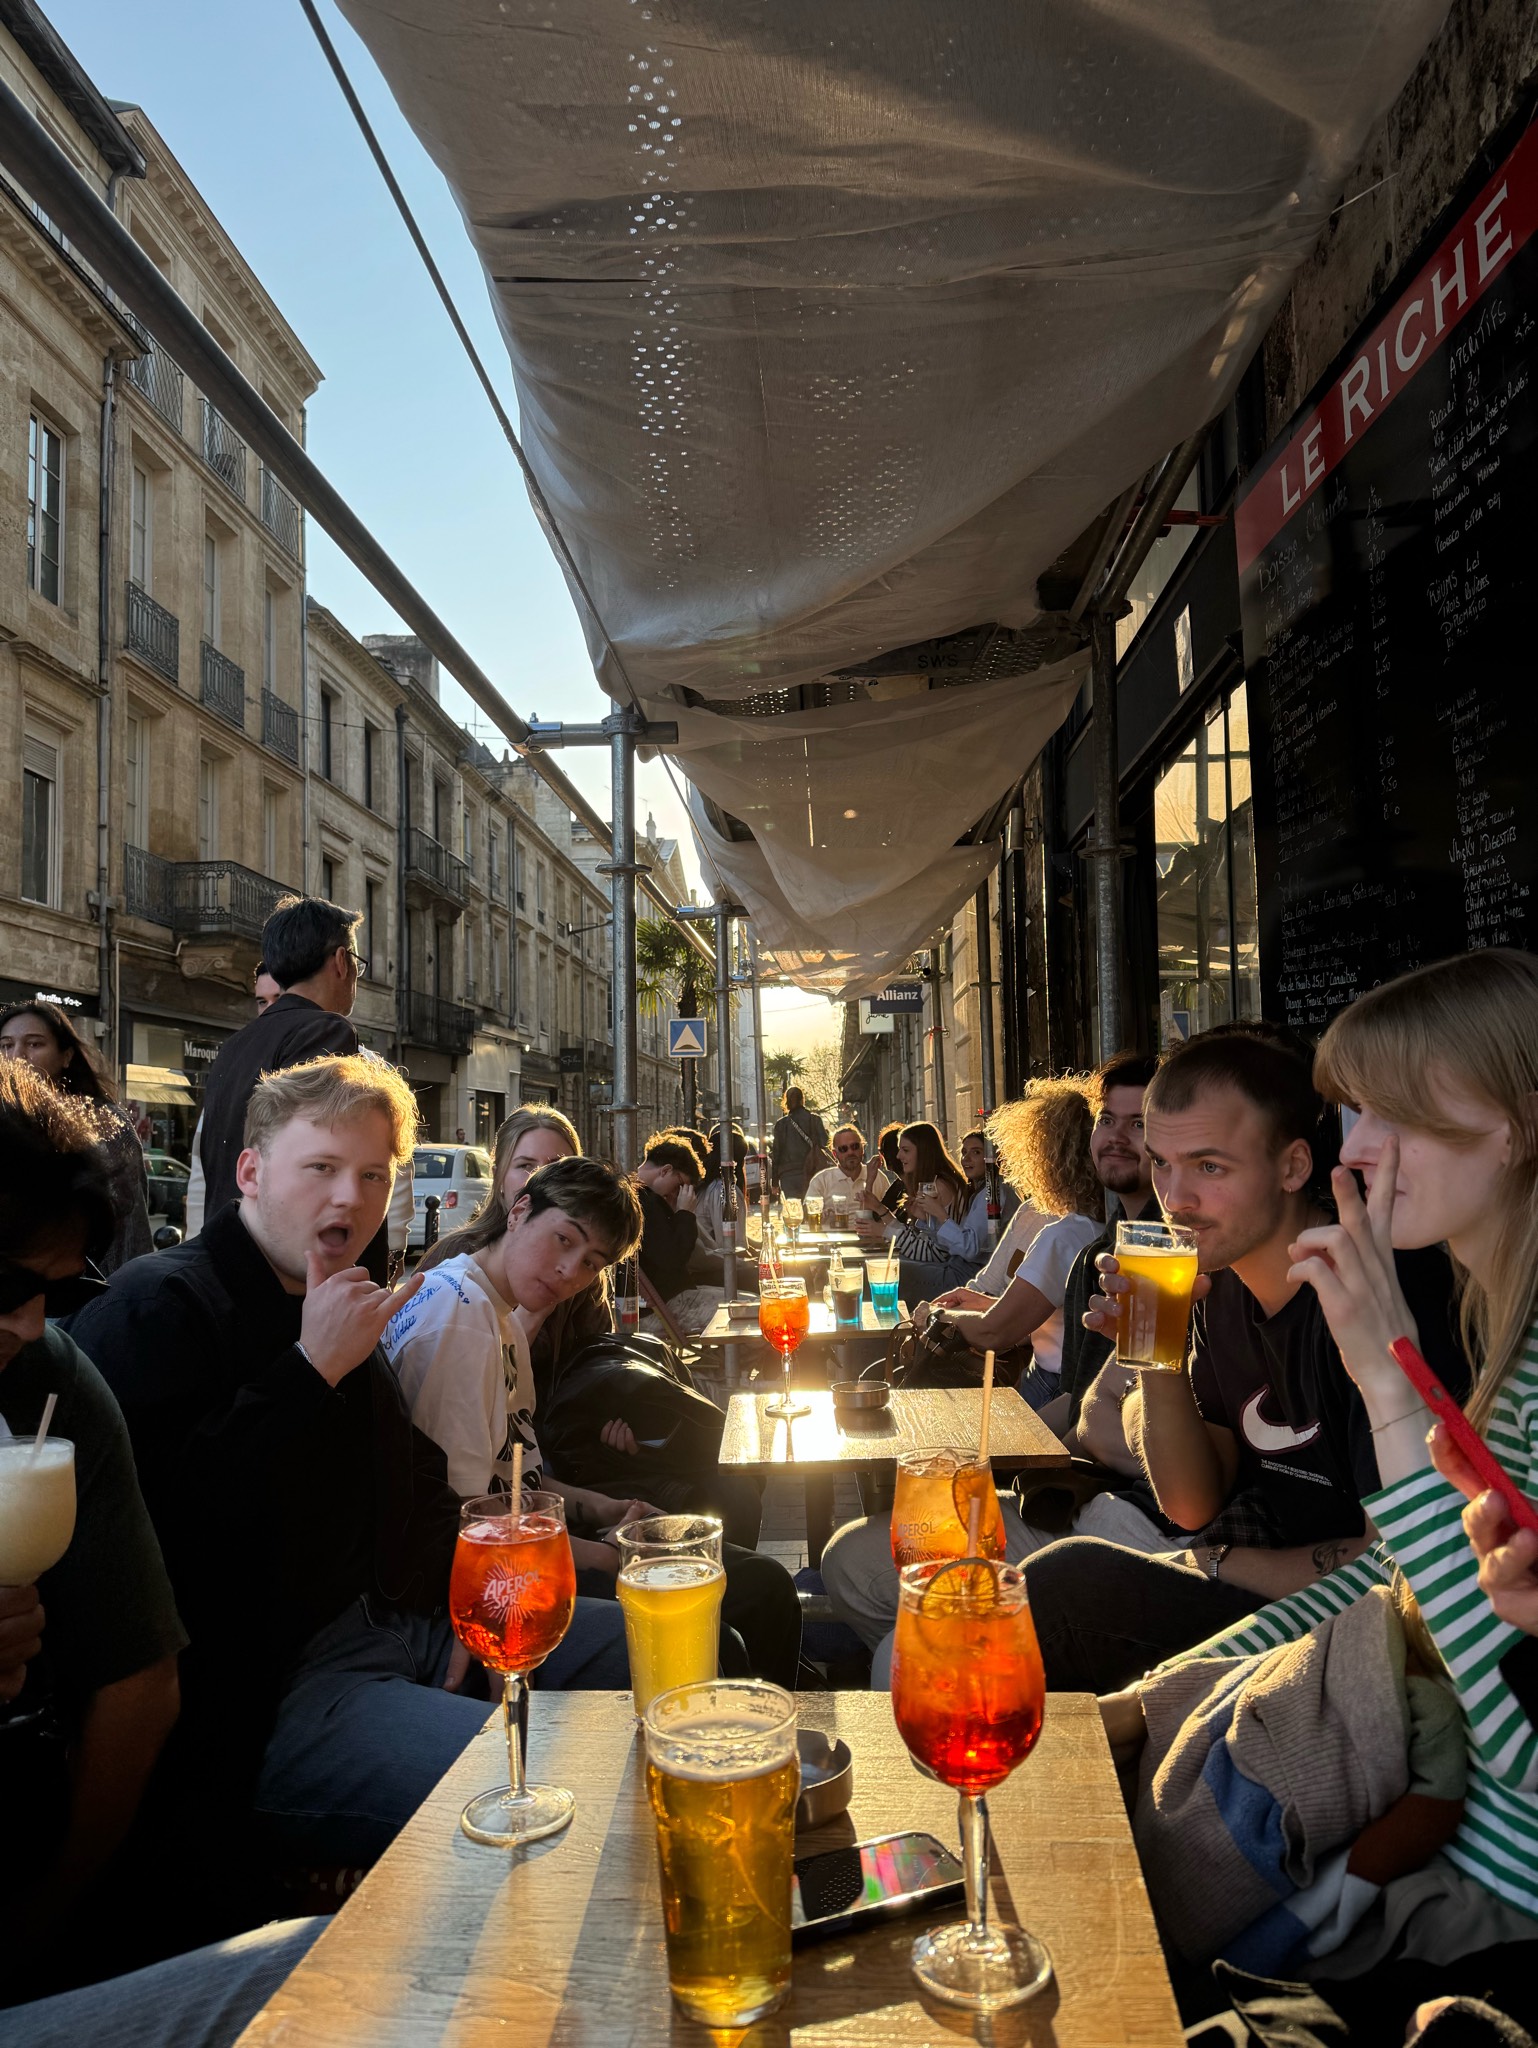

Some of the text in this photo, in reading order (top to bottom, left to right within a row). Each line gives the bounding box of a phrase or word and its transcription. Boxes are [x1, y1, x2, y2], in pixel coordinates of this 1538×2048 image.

[1280, 418, 1327, 518] LE
[1340, 180, 1513, 444] RICHE
[917, 653, 959, 669] SWS
[876, 990, 918, 1001] Allianz
[484, 1570, 542, 1601] APEROL
